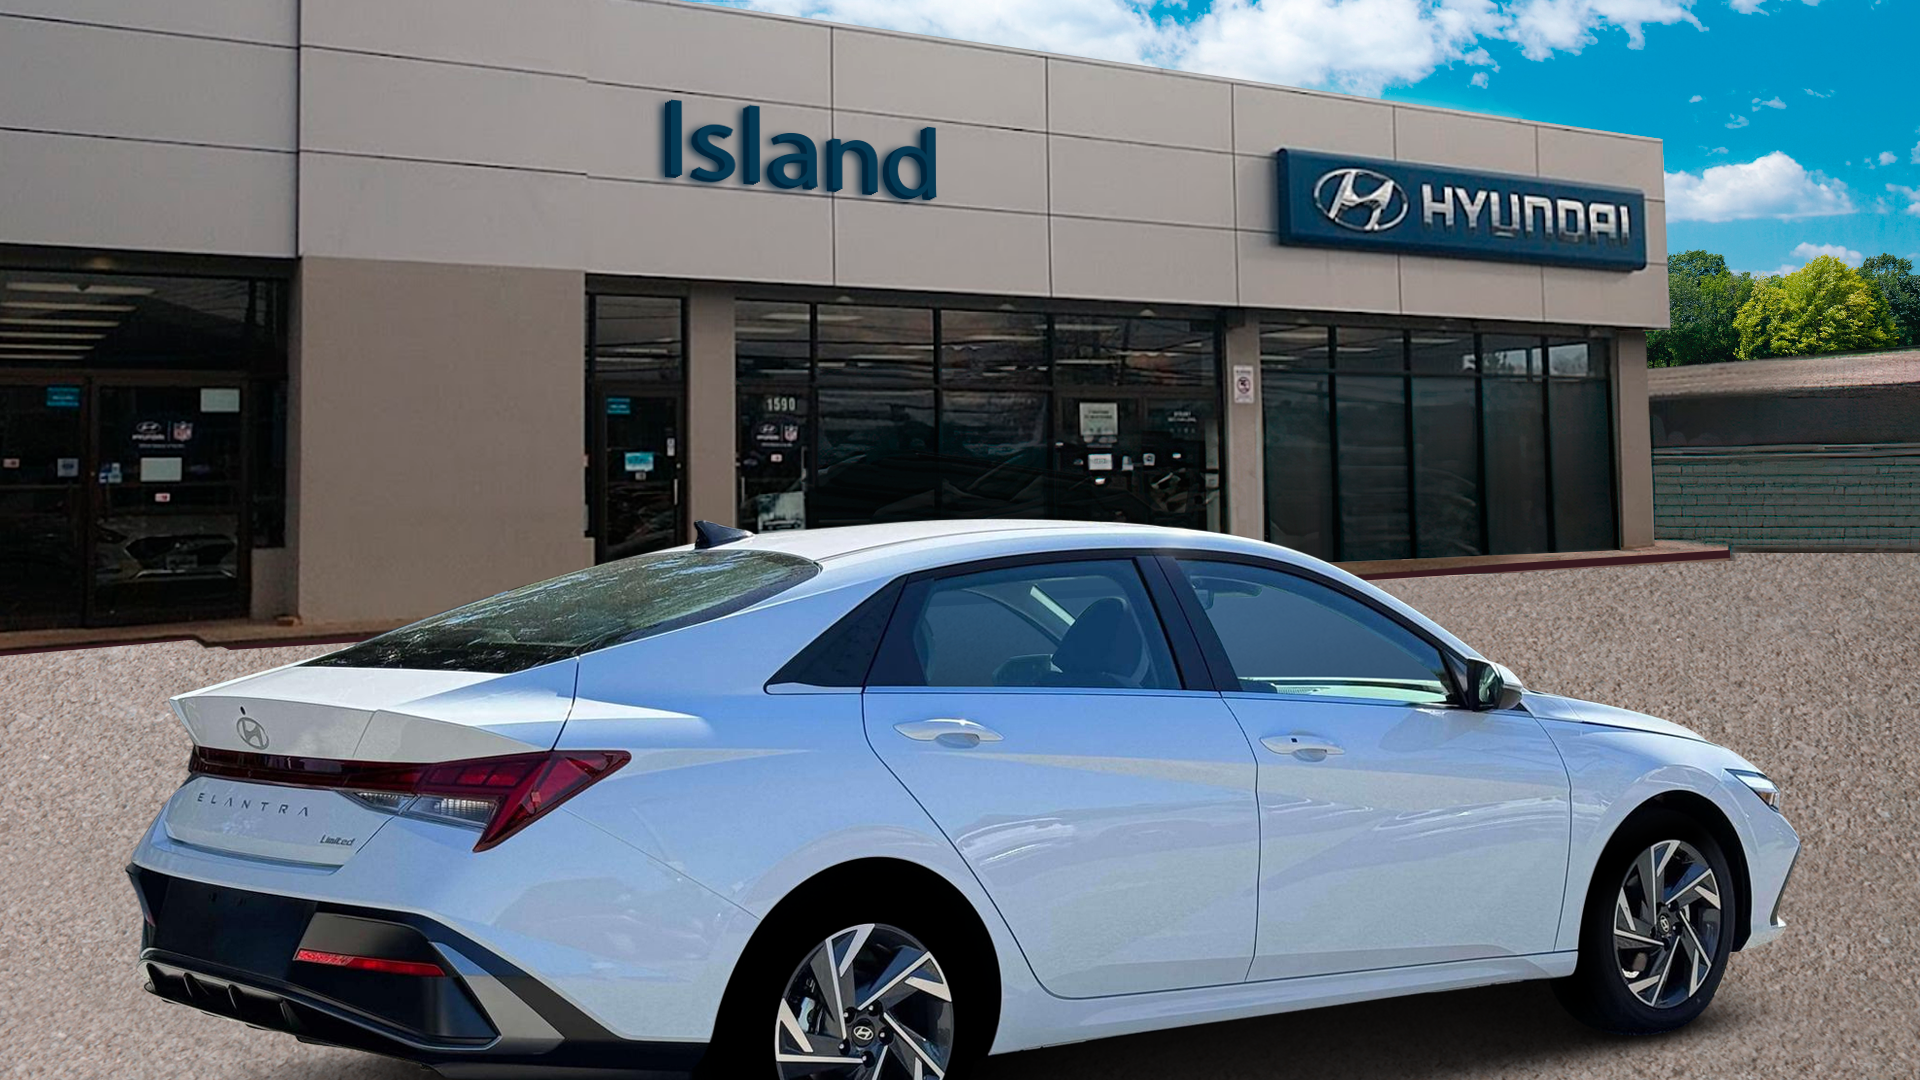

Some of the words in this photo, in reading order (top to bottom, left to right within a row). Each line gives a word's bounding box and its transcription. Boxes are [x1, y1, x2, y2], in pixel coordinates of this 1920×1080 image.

[664, 99, 937, 201] Island
[1421, 183, 1632, 243] HYUNDAI
[766, 396, 796, 412] 1590
[196, 792, 309, 817] ELANTRA
[319, 834, 355, 846] Limited
